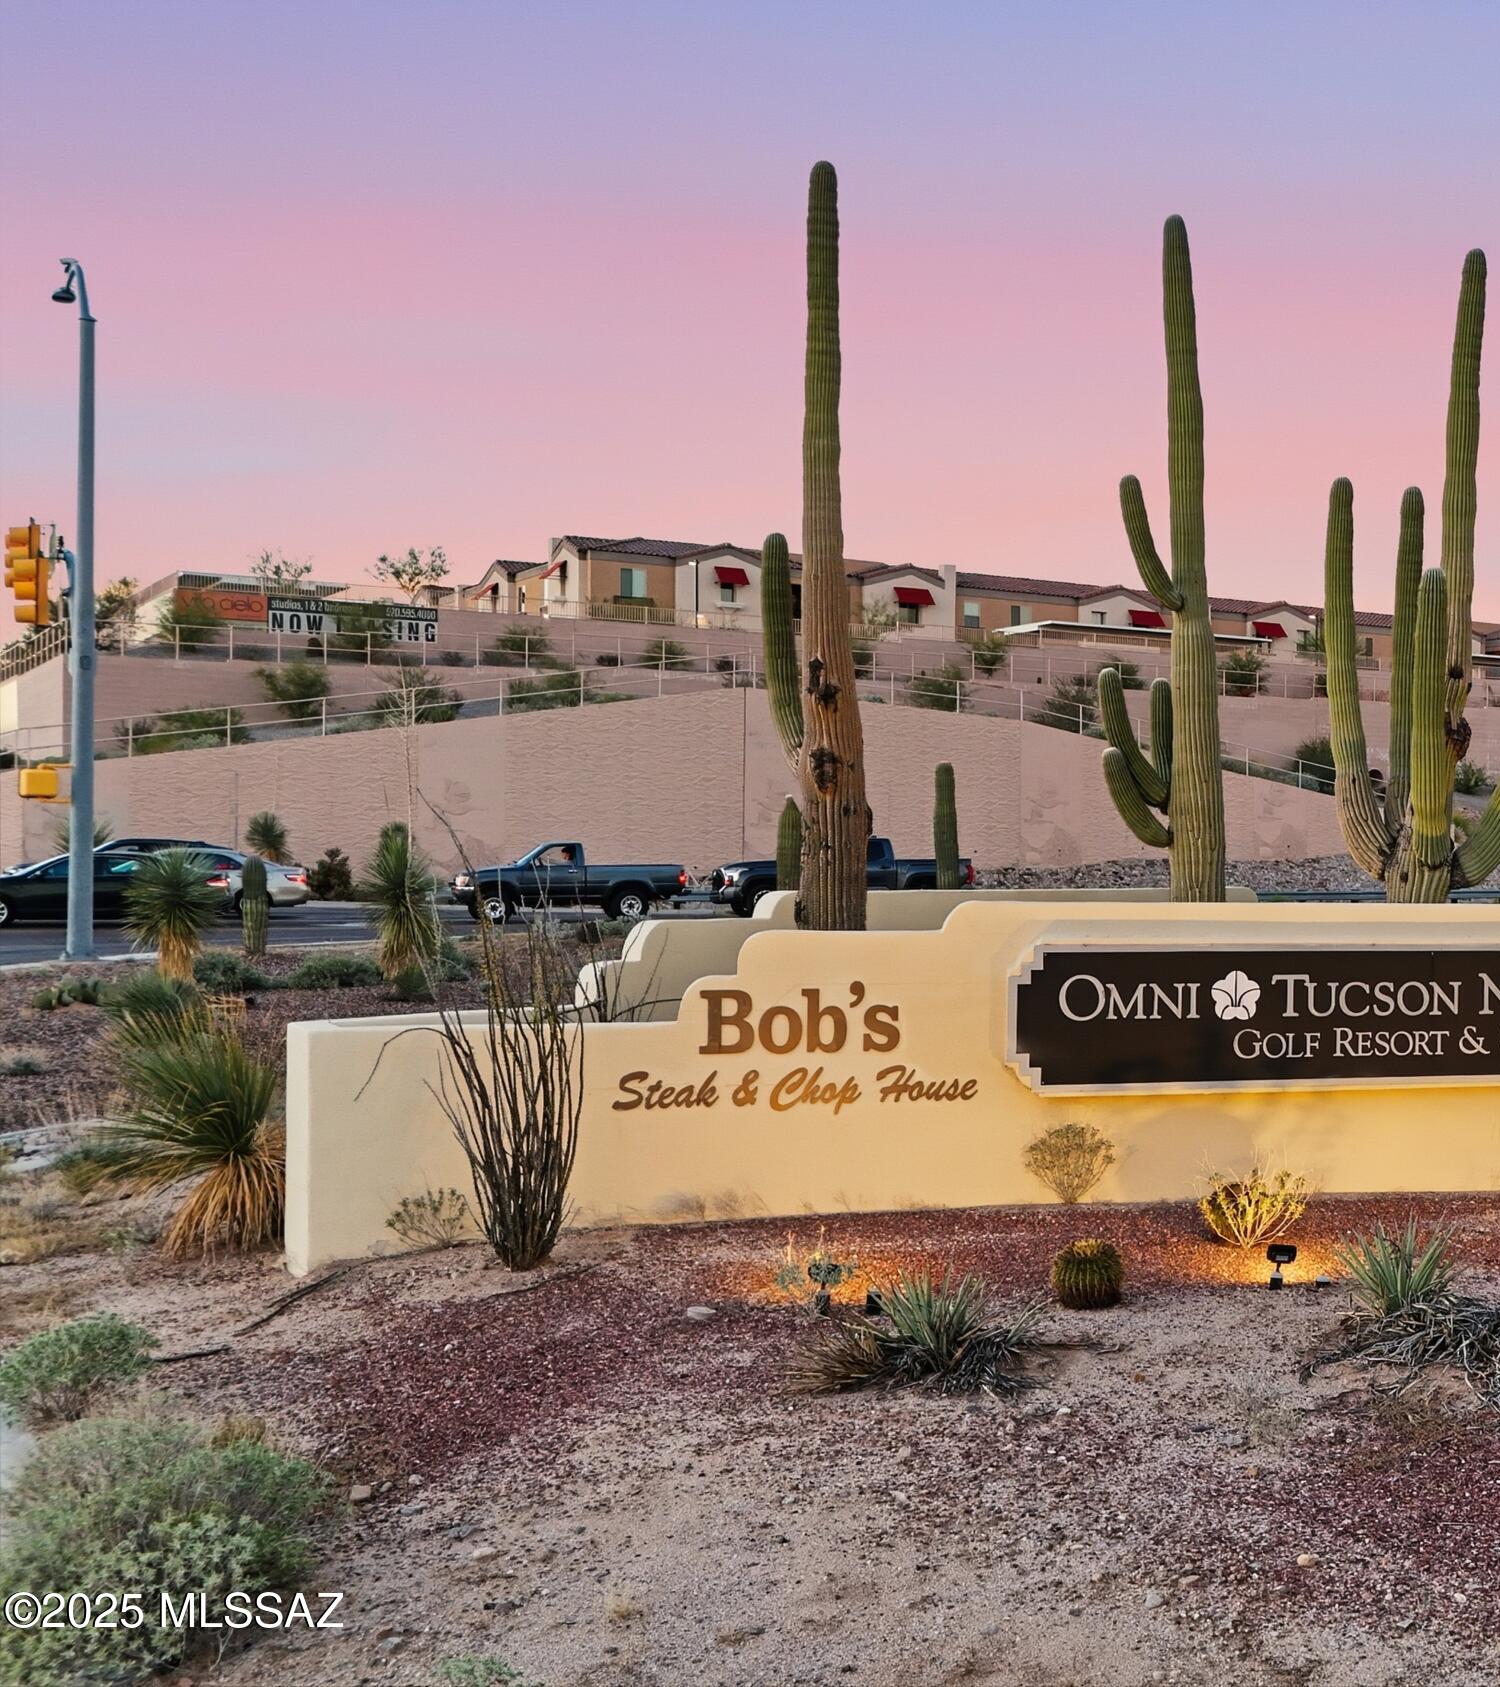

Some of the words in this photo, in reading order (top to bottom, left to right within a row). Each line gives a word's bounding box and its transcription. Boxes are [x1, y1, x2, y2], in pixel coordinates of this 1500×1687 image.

[219, 595, 264, 613] cielo
[310, 601, 317, 611] &
[317, 601, 323, 612] 2
[271, 612, 324, 635] NOW
[336, 614, 436, 643] LSING
[1058, 974, 1201, 1022] OMNI
[1271, 973, 1462, 1017] TUCSON
[698, 980, 901, 1055] Bob’s
[1458, 1025, 1491, 1055] &
[611, 1069, 721, 1112] Steak
[731, 1069, 760, 1107] &
[769, 1065, 861, 1116] Chop
[875, 1063, 979, 1105] House
